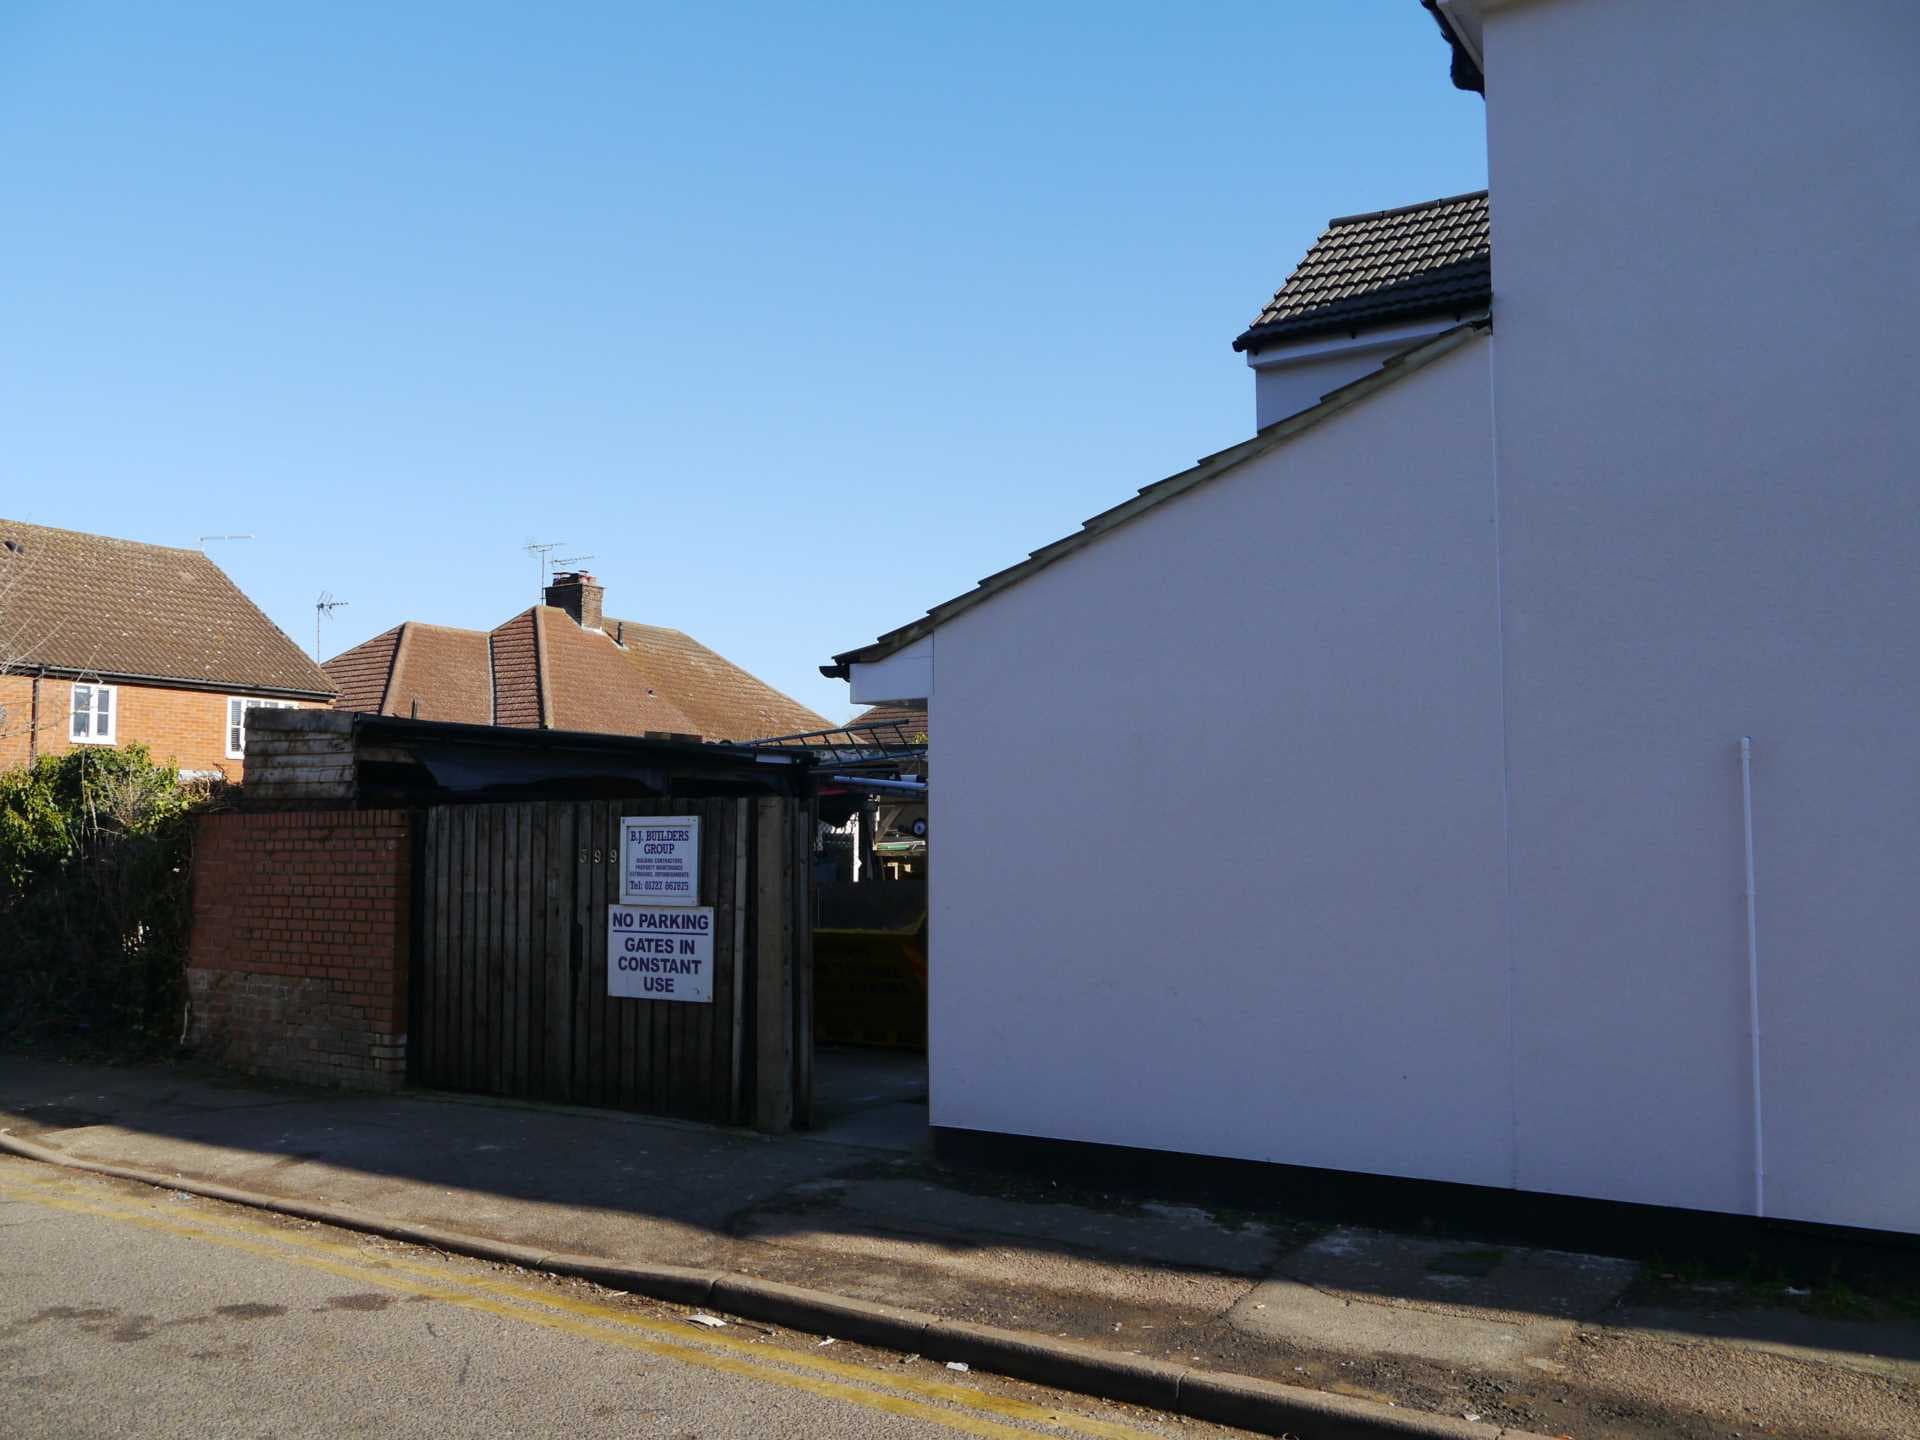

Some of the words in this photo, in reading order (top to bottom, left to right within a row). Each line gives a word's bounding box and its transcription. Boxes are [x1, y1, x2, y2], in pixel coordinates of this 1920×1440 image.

[646, 831, 689, 841] BUILDERS
[644, 843, 675, 855] GROUP
[630, 880, 642, 890] Tel:
[613, 912, 634, 928] NO
[639, 913, 709, 930] PARKING
[624, 937, 674, 954] GATES
[680, 939, 695, 955] IN
[618, 956, 702, 975] CONSTANT
[643, 976, 675, 993] USE
